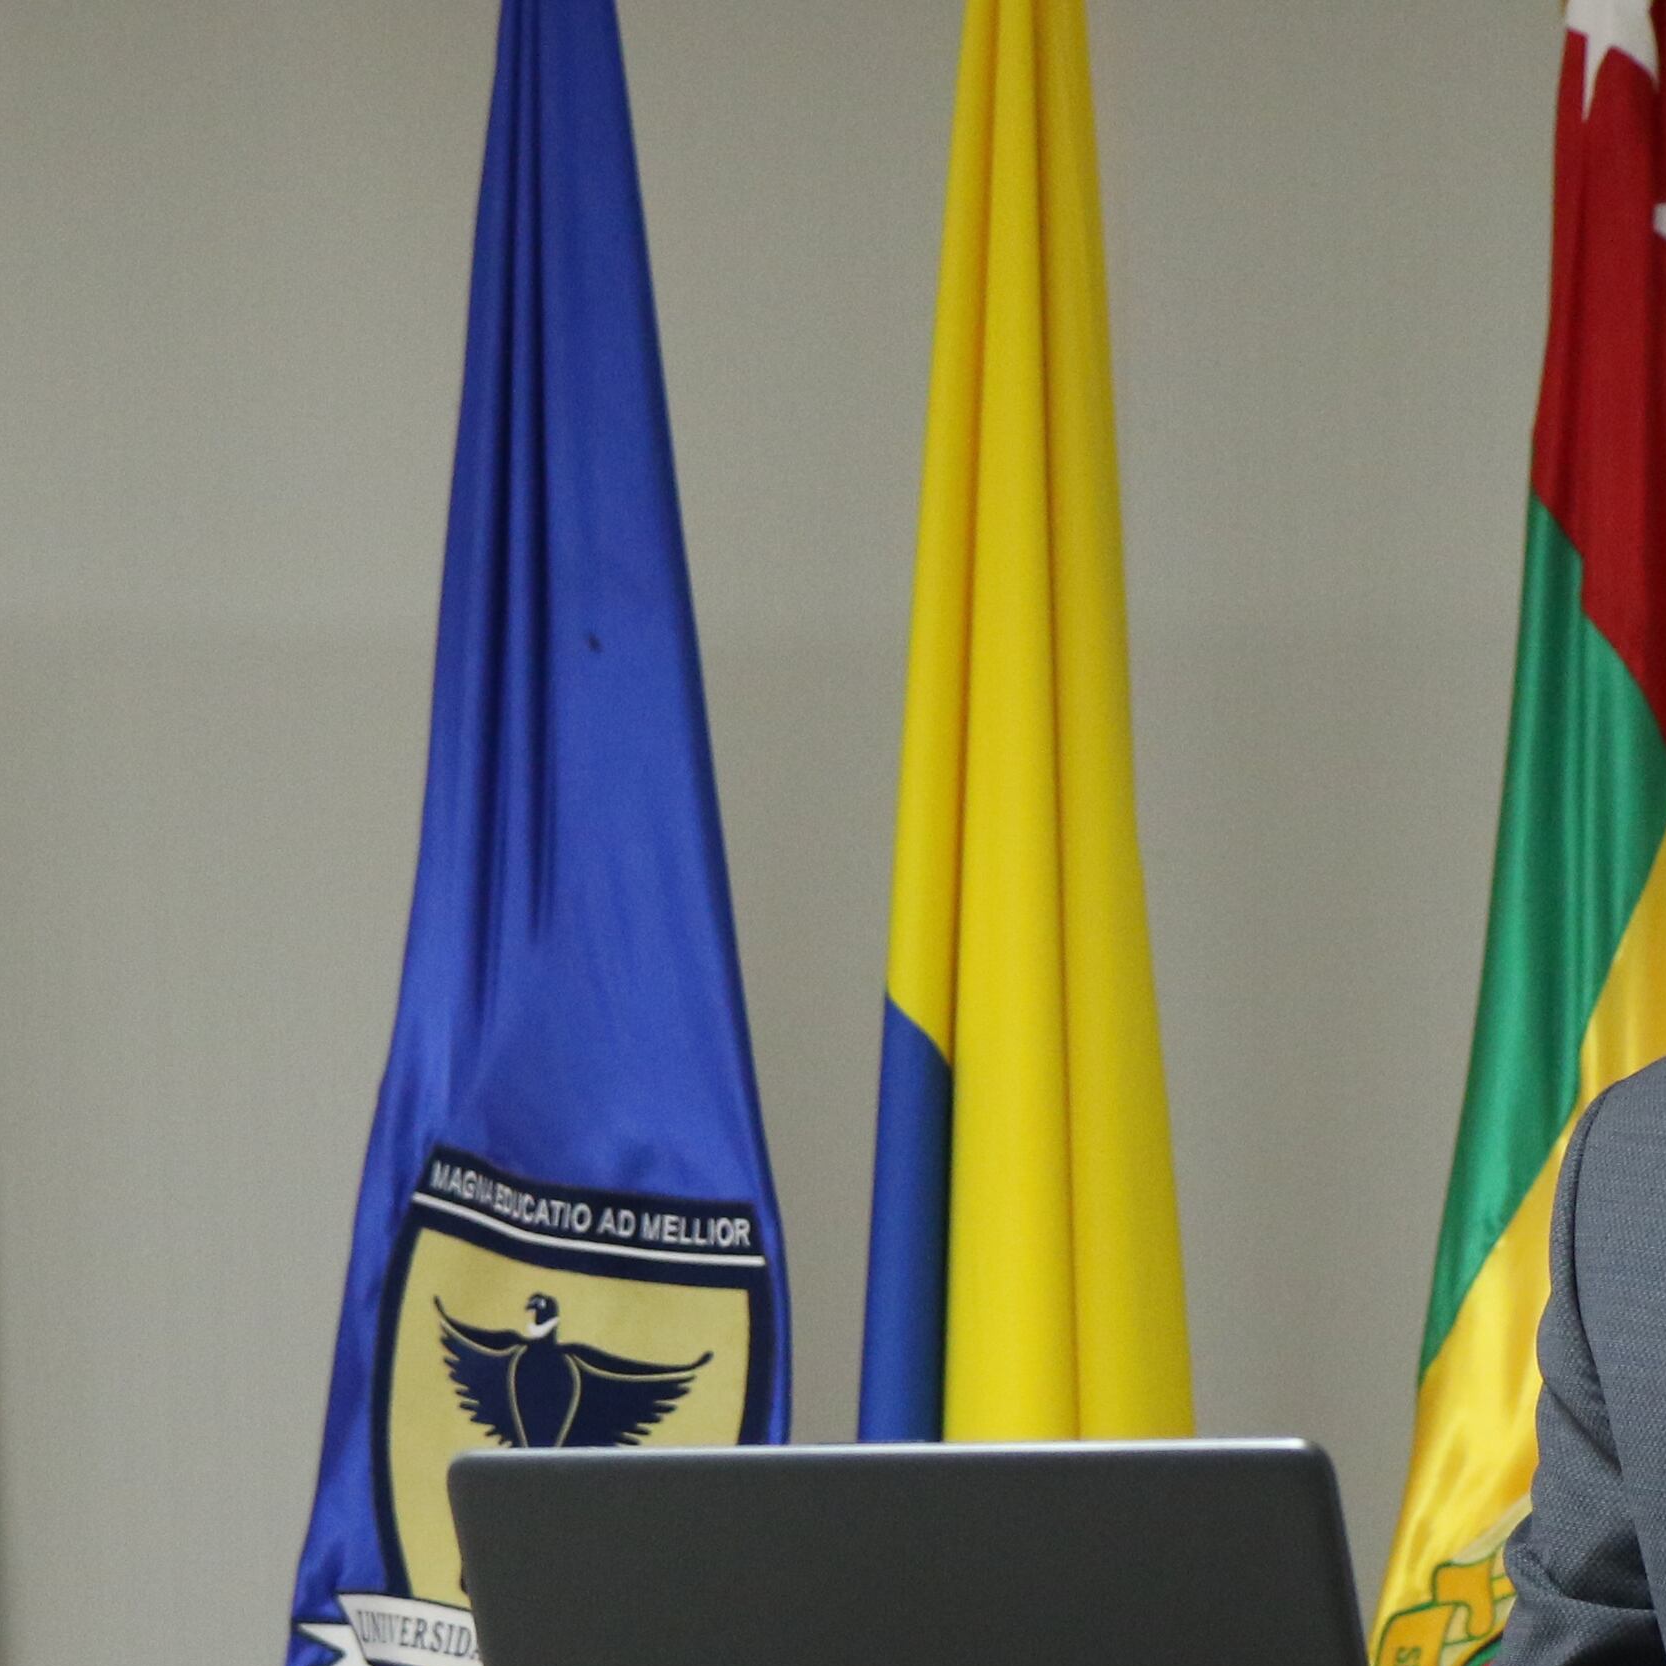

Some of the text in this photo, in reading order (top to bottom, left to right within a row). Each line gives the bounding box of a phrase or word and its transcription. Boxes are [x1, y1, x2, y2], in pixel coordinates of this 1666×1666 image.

[431, 1160, 751, 1247] MAGNA EDUCATIO AD MELLIOR
